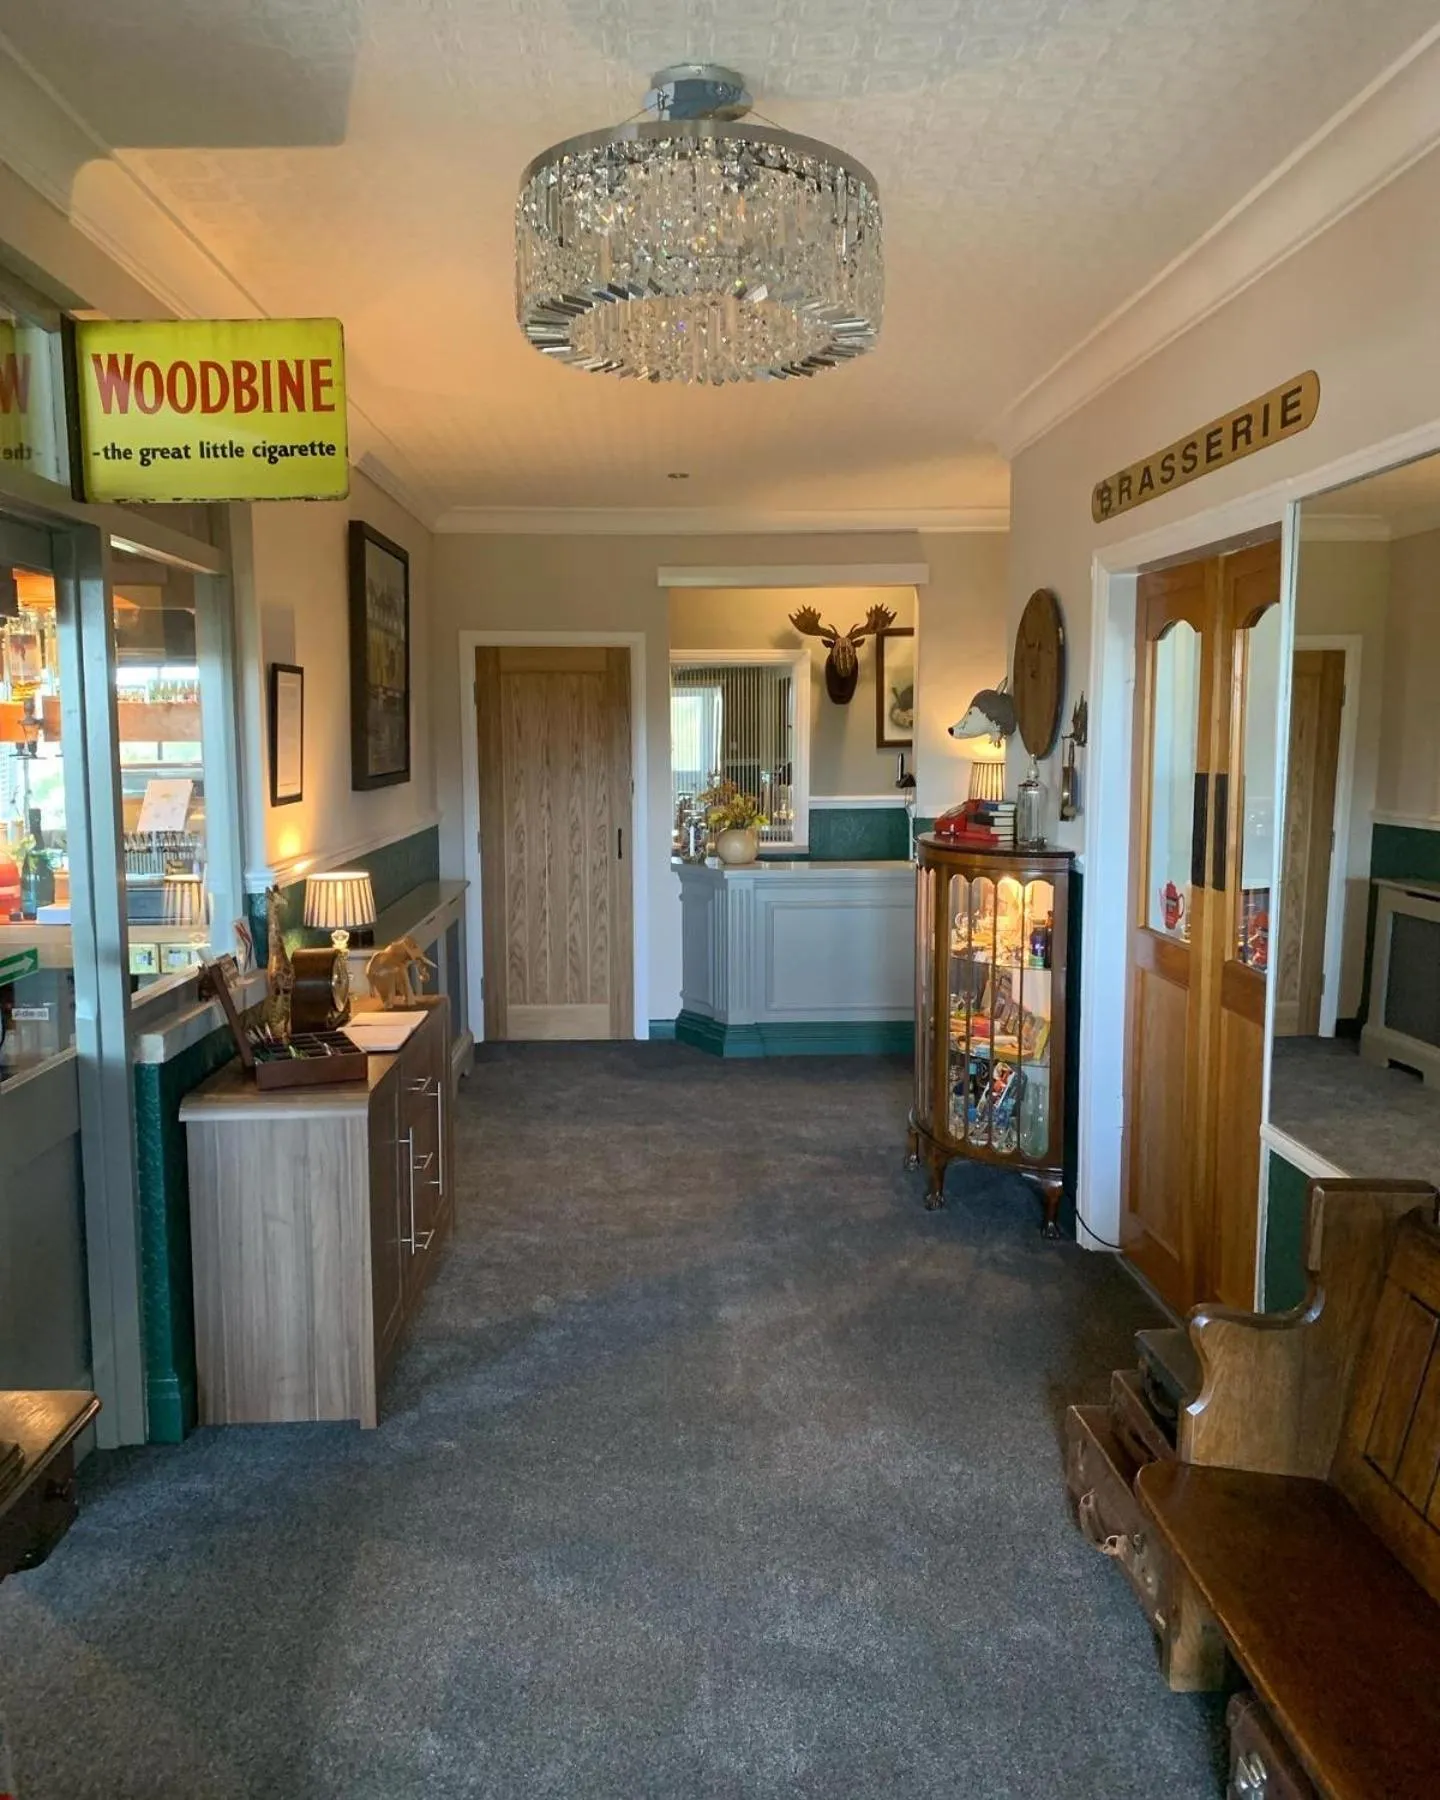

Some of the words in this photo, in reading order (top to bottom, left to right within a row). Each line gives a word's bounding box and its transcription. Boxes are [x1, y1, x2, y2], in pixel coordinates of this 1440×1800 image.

[92, 352, 336, 415] WOODBINE
[139, 443, 192, 467] great
[199, 440, 244, 459] little
[252, 440, 336, 464] cigarette
[1099, 385, 1303, 516] BRASSERIE
